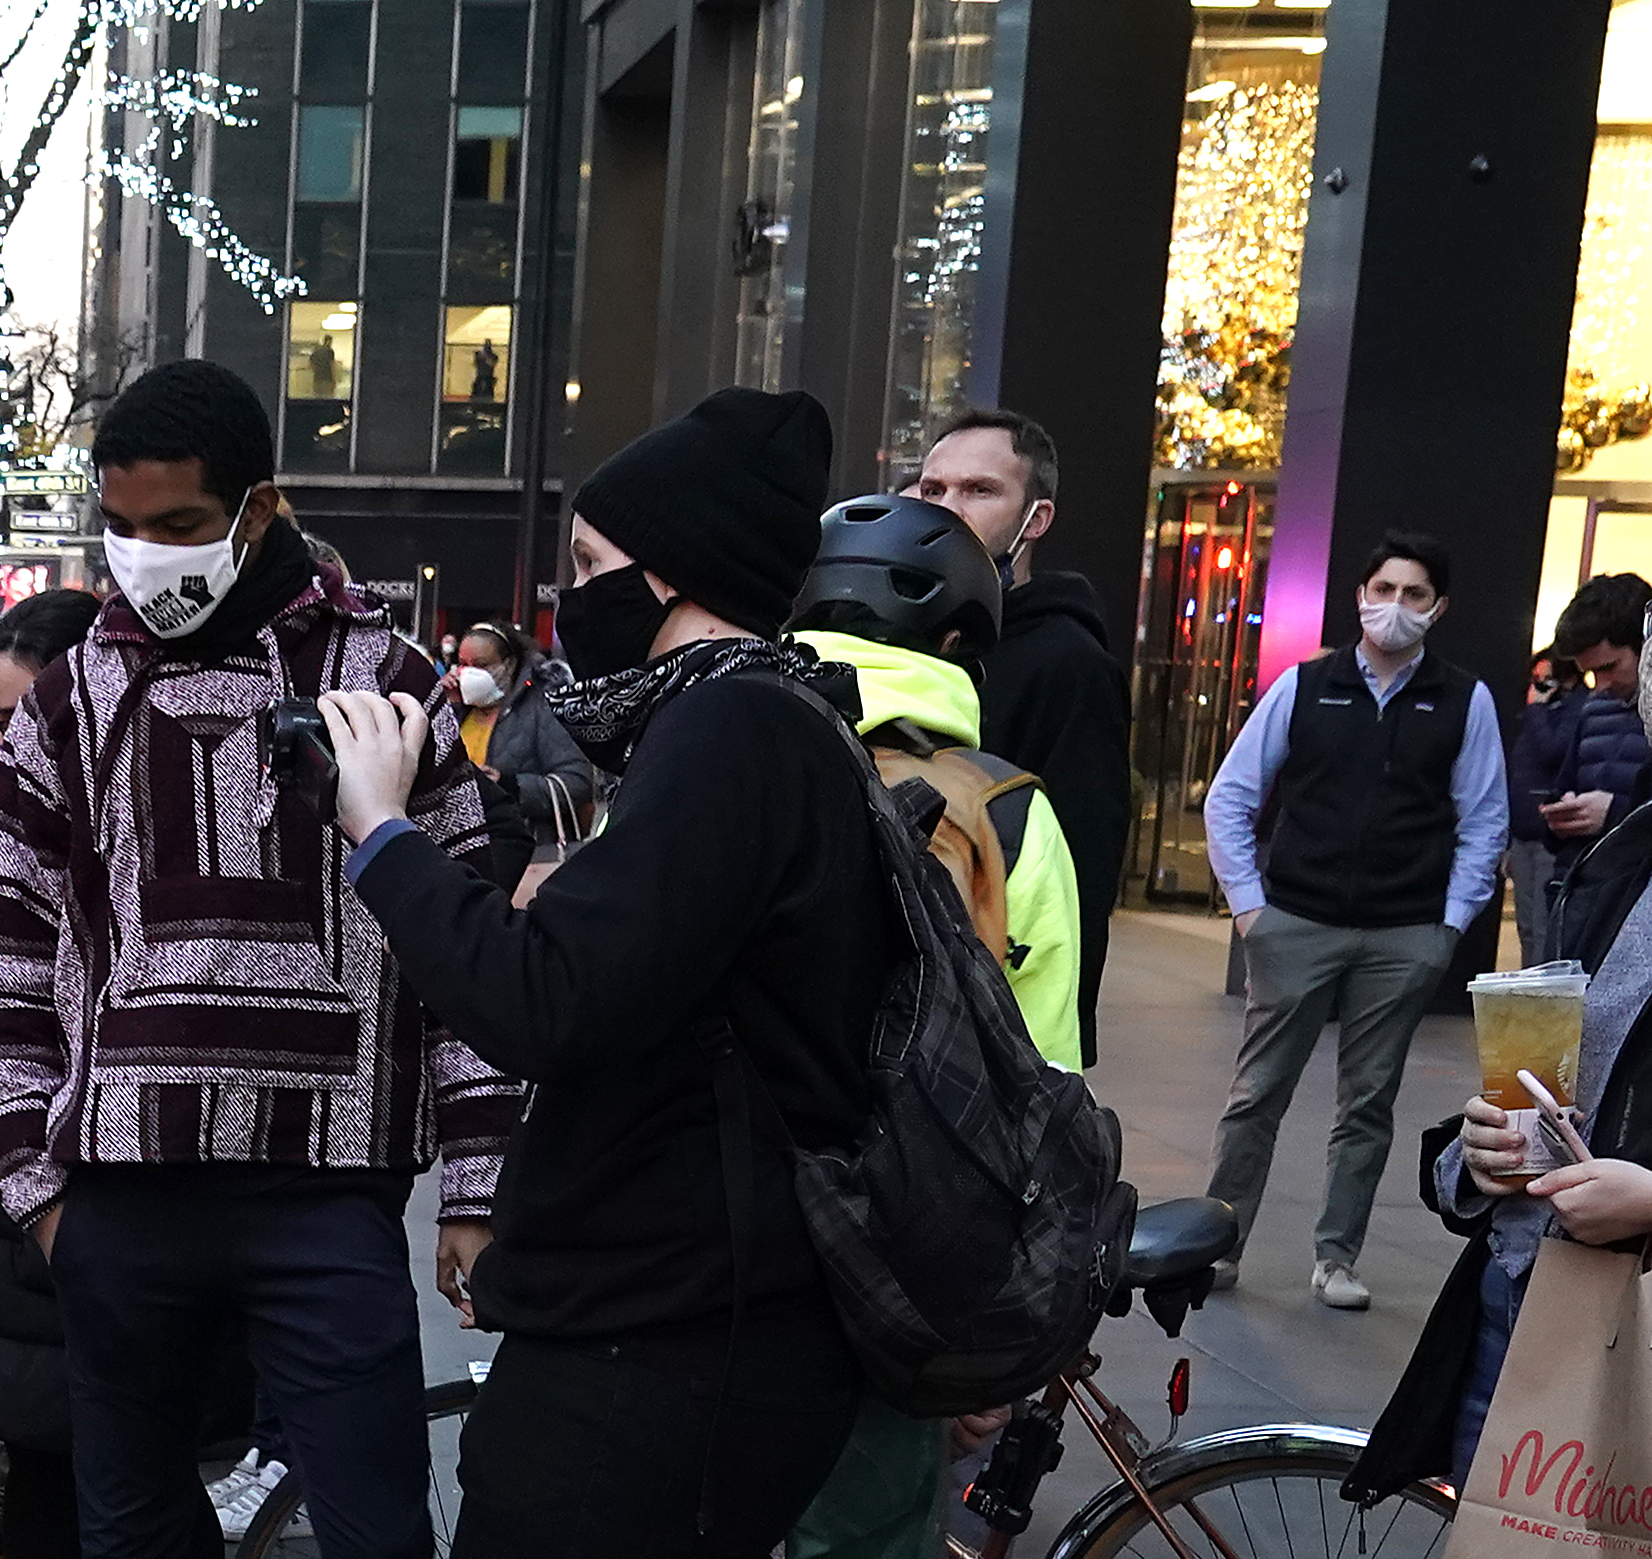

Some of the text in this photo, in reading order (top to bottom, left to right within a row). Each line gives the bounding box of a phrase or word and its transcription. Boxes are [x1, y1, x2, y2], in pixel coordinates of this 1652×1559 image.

[139, 587, 175, 615] BLACK
[1500, 1514, 1558, 1541] MAKE
[1562, 1530, 1636, 1552] CREATIVITY
